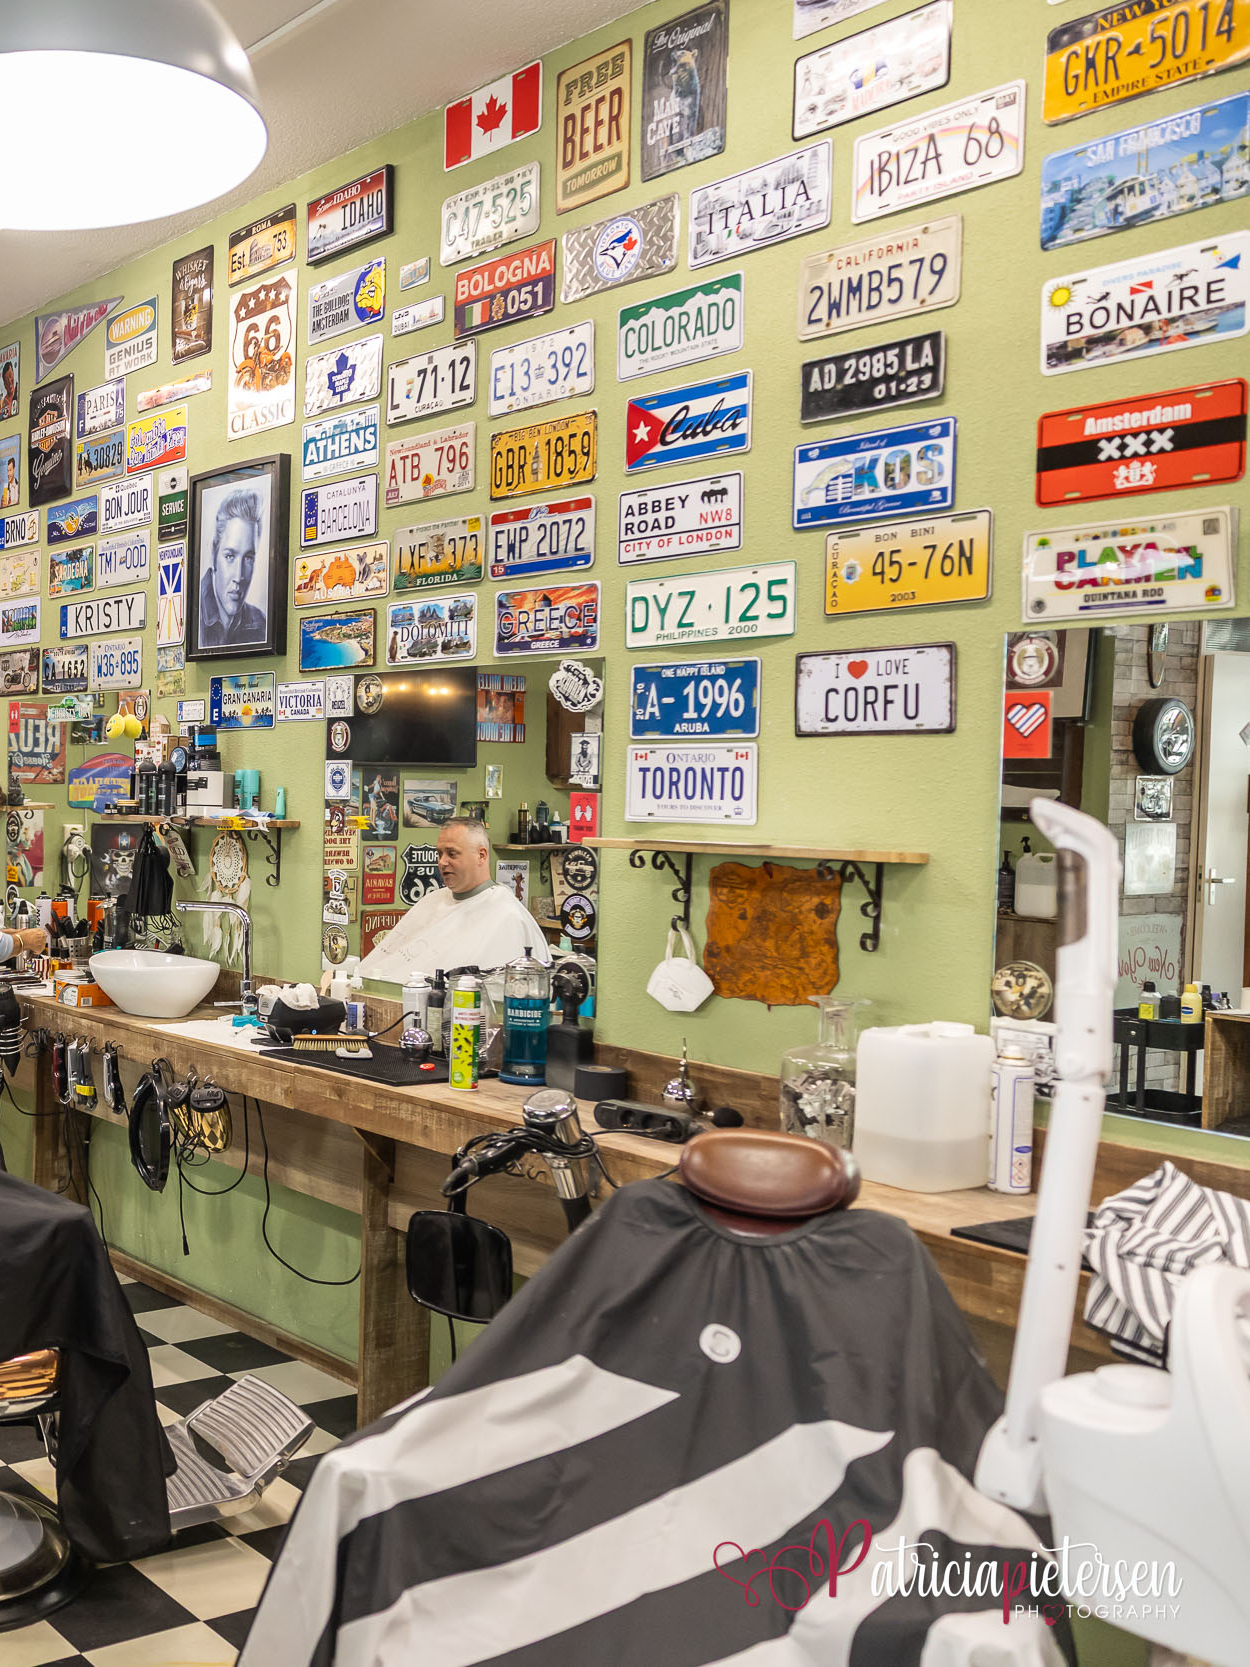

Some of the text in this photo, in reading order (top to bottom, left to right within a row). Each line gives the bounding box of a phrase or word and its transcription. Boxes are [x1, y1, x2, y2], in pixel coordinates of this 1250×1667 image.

[1097, 2, 1146, 33] NEW
[563, 52, 625, 105] FREE
[1093, 59, 1203, 103] EMPIRE STATE
[562, 86, 623, 171] BEER
[647, 115, 681, 146] CAVE
[870, 116, 1005, 197] IBIZA 68
[566, 157, 618, 194] TOMORROW
[341, 189, 383, 231] IDAHO
[707, 180, 812, 235] ITALIA
[252, 220, 271, 235] ROMA
[273, 230, 287, 253] 753
[231, 251, 247, 273] Est.
[836, 237, 919, 271] CALIFORNIA
[457, 251, 551, 302] BOLOGNA
[807, 252, 948, 325] 2WMB579
[312, 294, 350, 316] THE BULLDOG
[506, 284, 544, 316] 051
[1066, 278, 1226, 336] BONAIRE
[110, 308, 151, 340] WARNING
[312, 308, 350, 334] AMSTERDAM
[624, 297, 735, 360] COLORADO
[109, 336, 153, 365] GENIUS
[808, 340, 934, 393] AD 2985 LA
[86, 391, 115, 415] PARIS
[231, 400, 290, 434] CLASSIC
[79, 419, 84, 432] F
[659, 397, 742, 447] Cuba
[1083, 403, 1192, 436] Amsterdam
[305, 426, 375, 465] ATHENS
[494, 430, 591, 489] GBR 1859
[389, 441, 469, 488] ATB 796
[853, 443, 943, 495] KOS
[104, 496, 122, 522] BON
[124, 488, 148, 517] JOUR
[162, 500, 184, 516] SERVICE
[326, 484, 366, 500] CATALUNYA
[624, 494, 689, 518] ABBEY
[5, 516, 26, 543] BRNO
[321, 499, 371, 535] BARCELONA
[624, 516, 676, 536] ROAD
[699, 508, 733, 525] NW8
[494, 517, 586, 564] EWP 2072
[624, 528, 733, 553] CITY OF LONDON
[875, 526, 935, 543] BON BINI
[871, 538, 975, 585] 45-76N
[416, 573, 458, 585] FLORIDA
[631, 578, 788, 633] DYZ 125
[890, 591, 916, 603] 2003
[75, 597, 135, 633] KRISTY
[400, 619, 469, 643] DOLOMITI
[500, 602, 596, 635] GREECE
[530, 639, 560, 648] GREECE
[656, 624, 758, 641] PHILIPPINES 2000
[44, 660, 85, 680] CA 1652
[835, 658, 910, 679] I LOVE
[222, 692, 242, 705] GRAN
[242, 688, 272, 703] CANARIA
[279, 693, 322, 709] VICTORIA
[824, 682, 921, 722] CORFU
[674, 723, 710, 733] ARUBA
[638, 766, 745, 801] TORONTO
[507, 1008, 542, 1018] BARBICIDE
